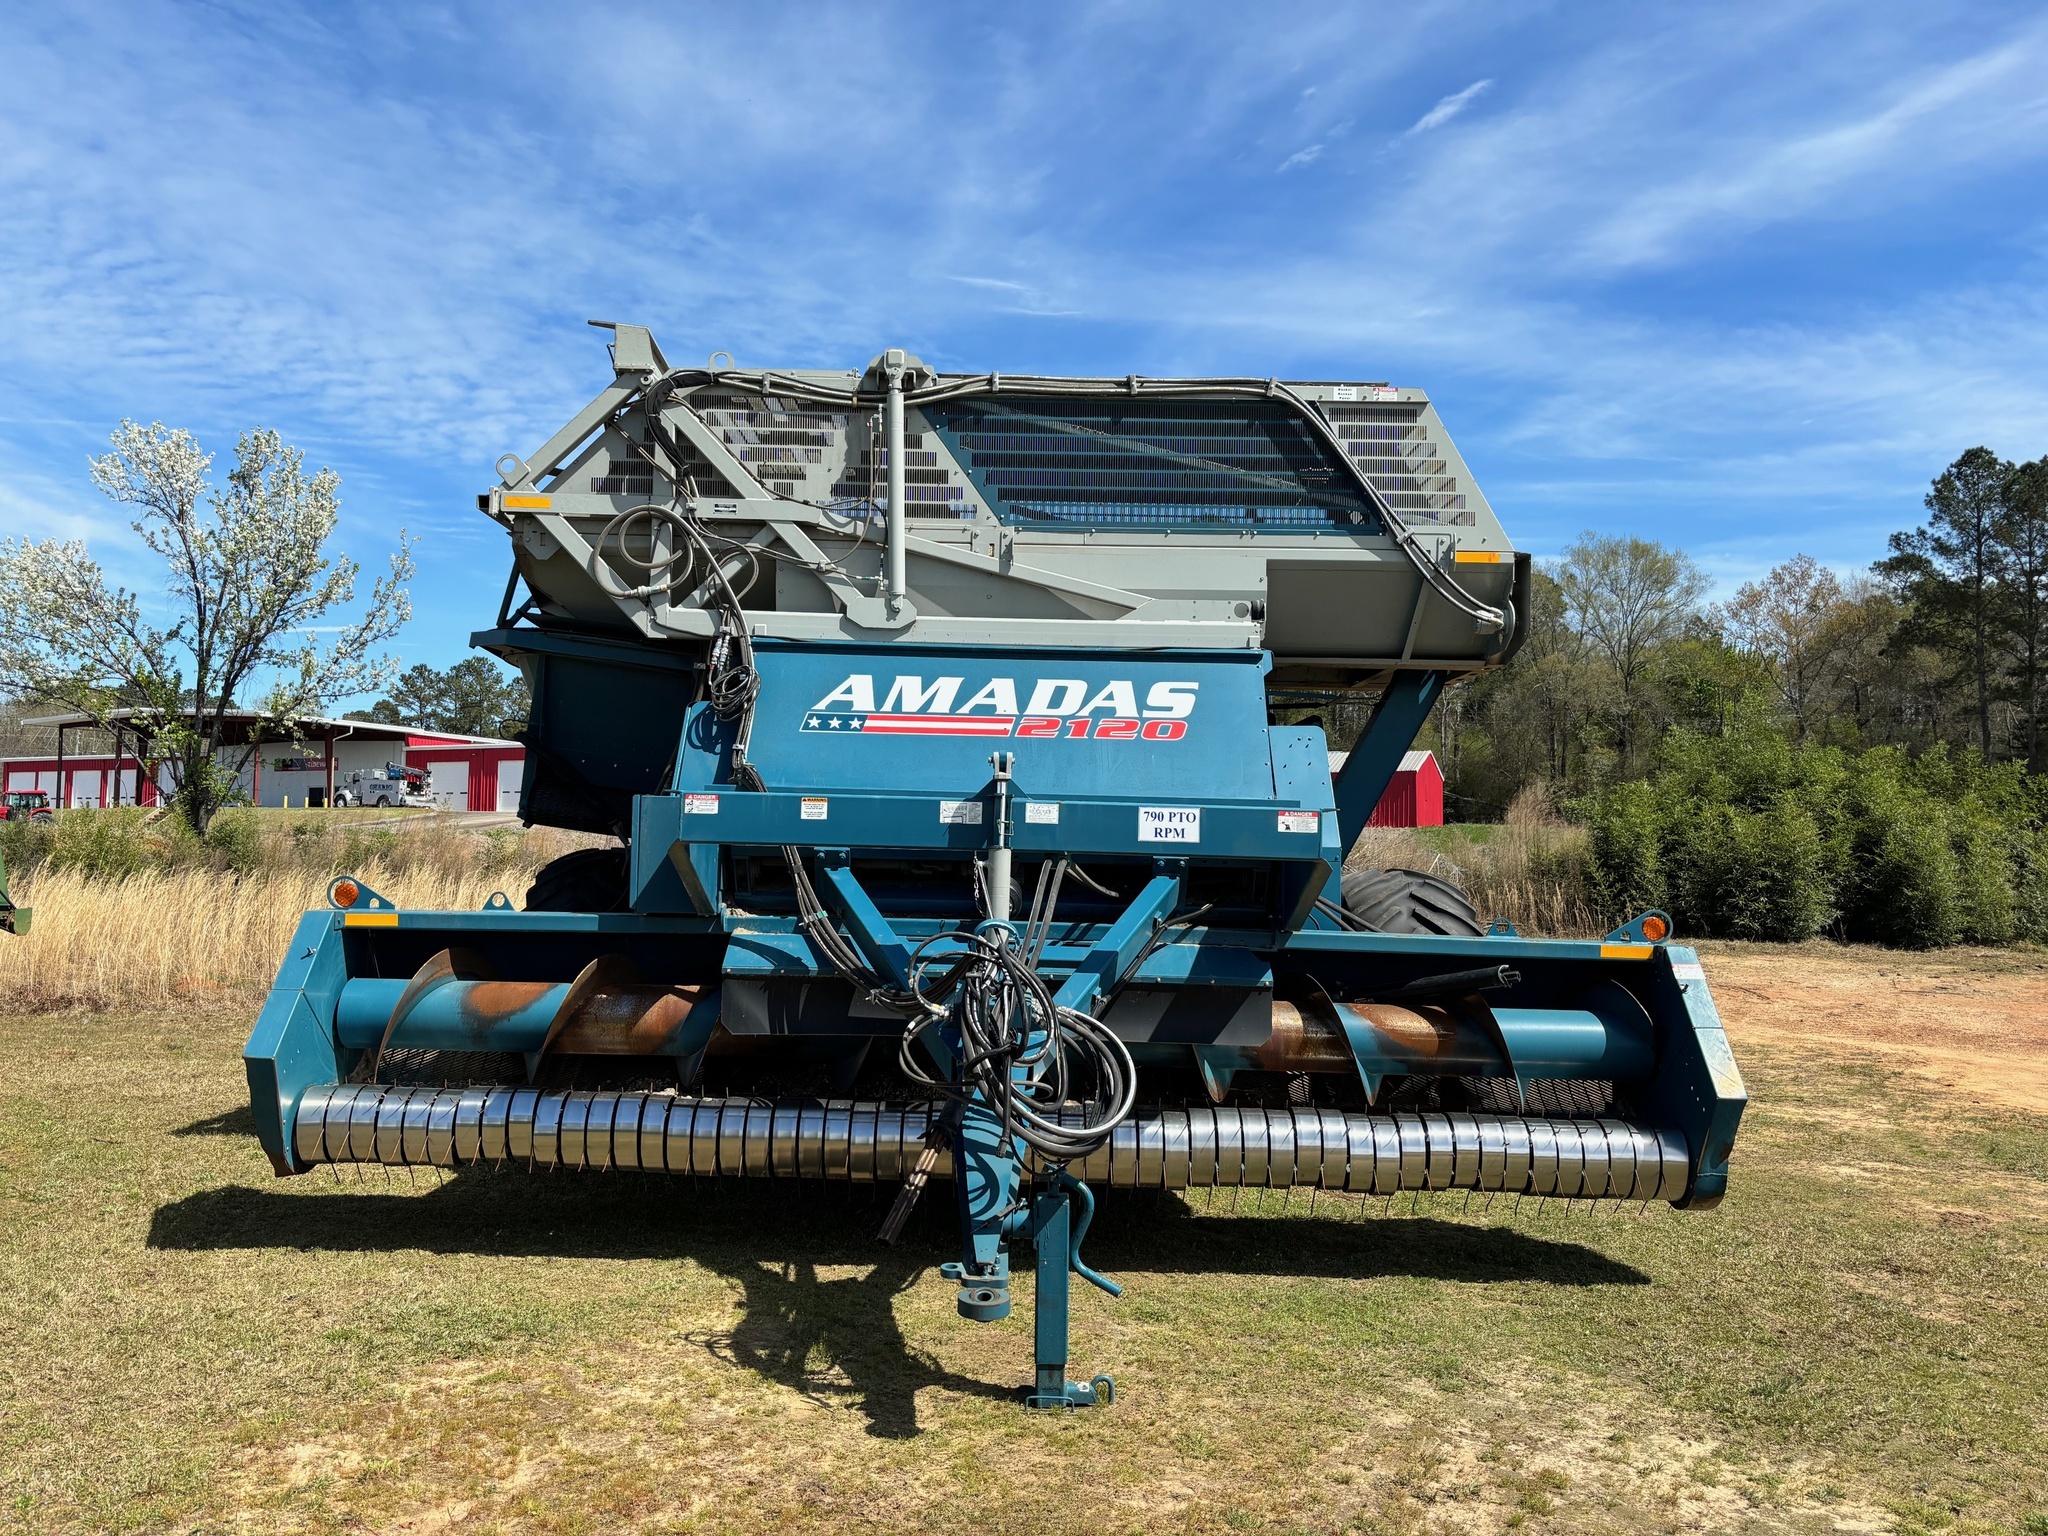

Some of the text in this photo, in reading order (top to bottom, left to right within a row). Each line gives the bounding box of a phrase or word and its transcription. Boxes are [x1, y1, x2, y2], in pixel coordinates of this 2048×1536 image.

[811, 674, 1200, 718] AMADAS
[1015, 717, 1188, 741] 2120
[1143, 811, 1197, 823] 790 PTO
[1154, 827, 1186, 839] RPM
